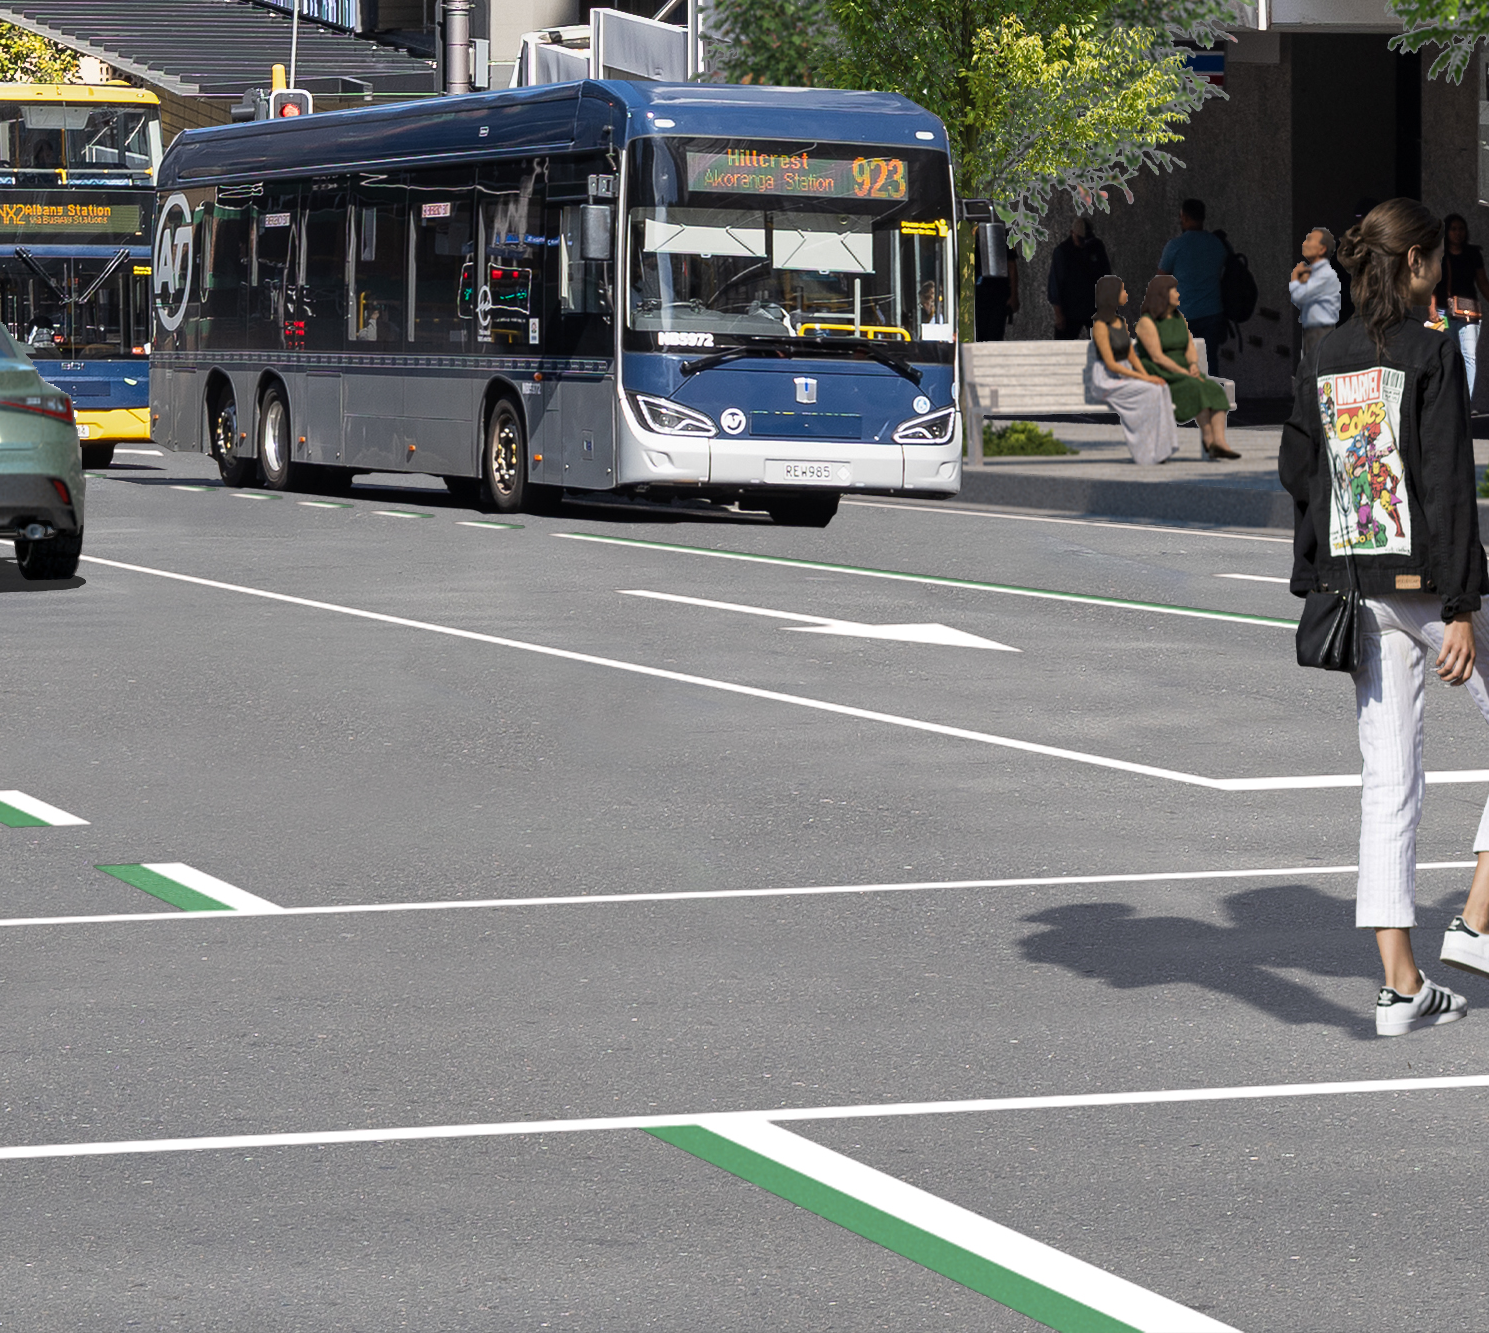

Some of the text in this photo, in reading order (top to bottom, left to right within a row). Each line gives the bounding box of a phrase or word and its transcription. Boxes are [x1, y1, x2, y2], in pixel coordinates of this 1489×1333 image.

[726, 148, 809, 170] Hillcrest
[704, 169, 834, 193] Akoranga Station
[851, 156, 907, 199] 923
[25, 204, 64, 216] Albany
[67, 204, 111, 216] Station
[1336, 370, 1380, 406] MARVEL
[785, 464, 831, 478] REW985
